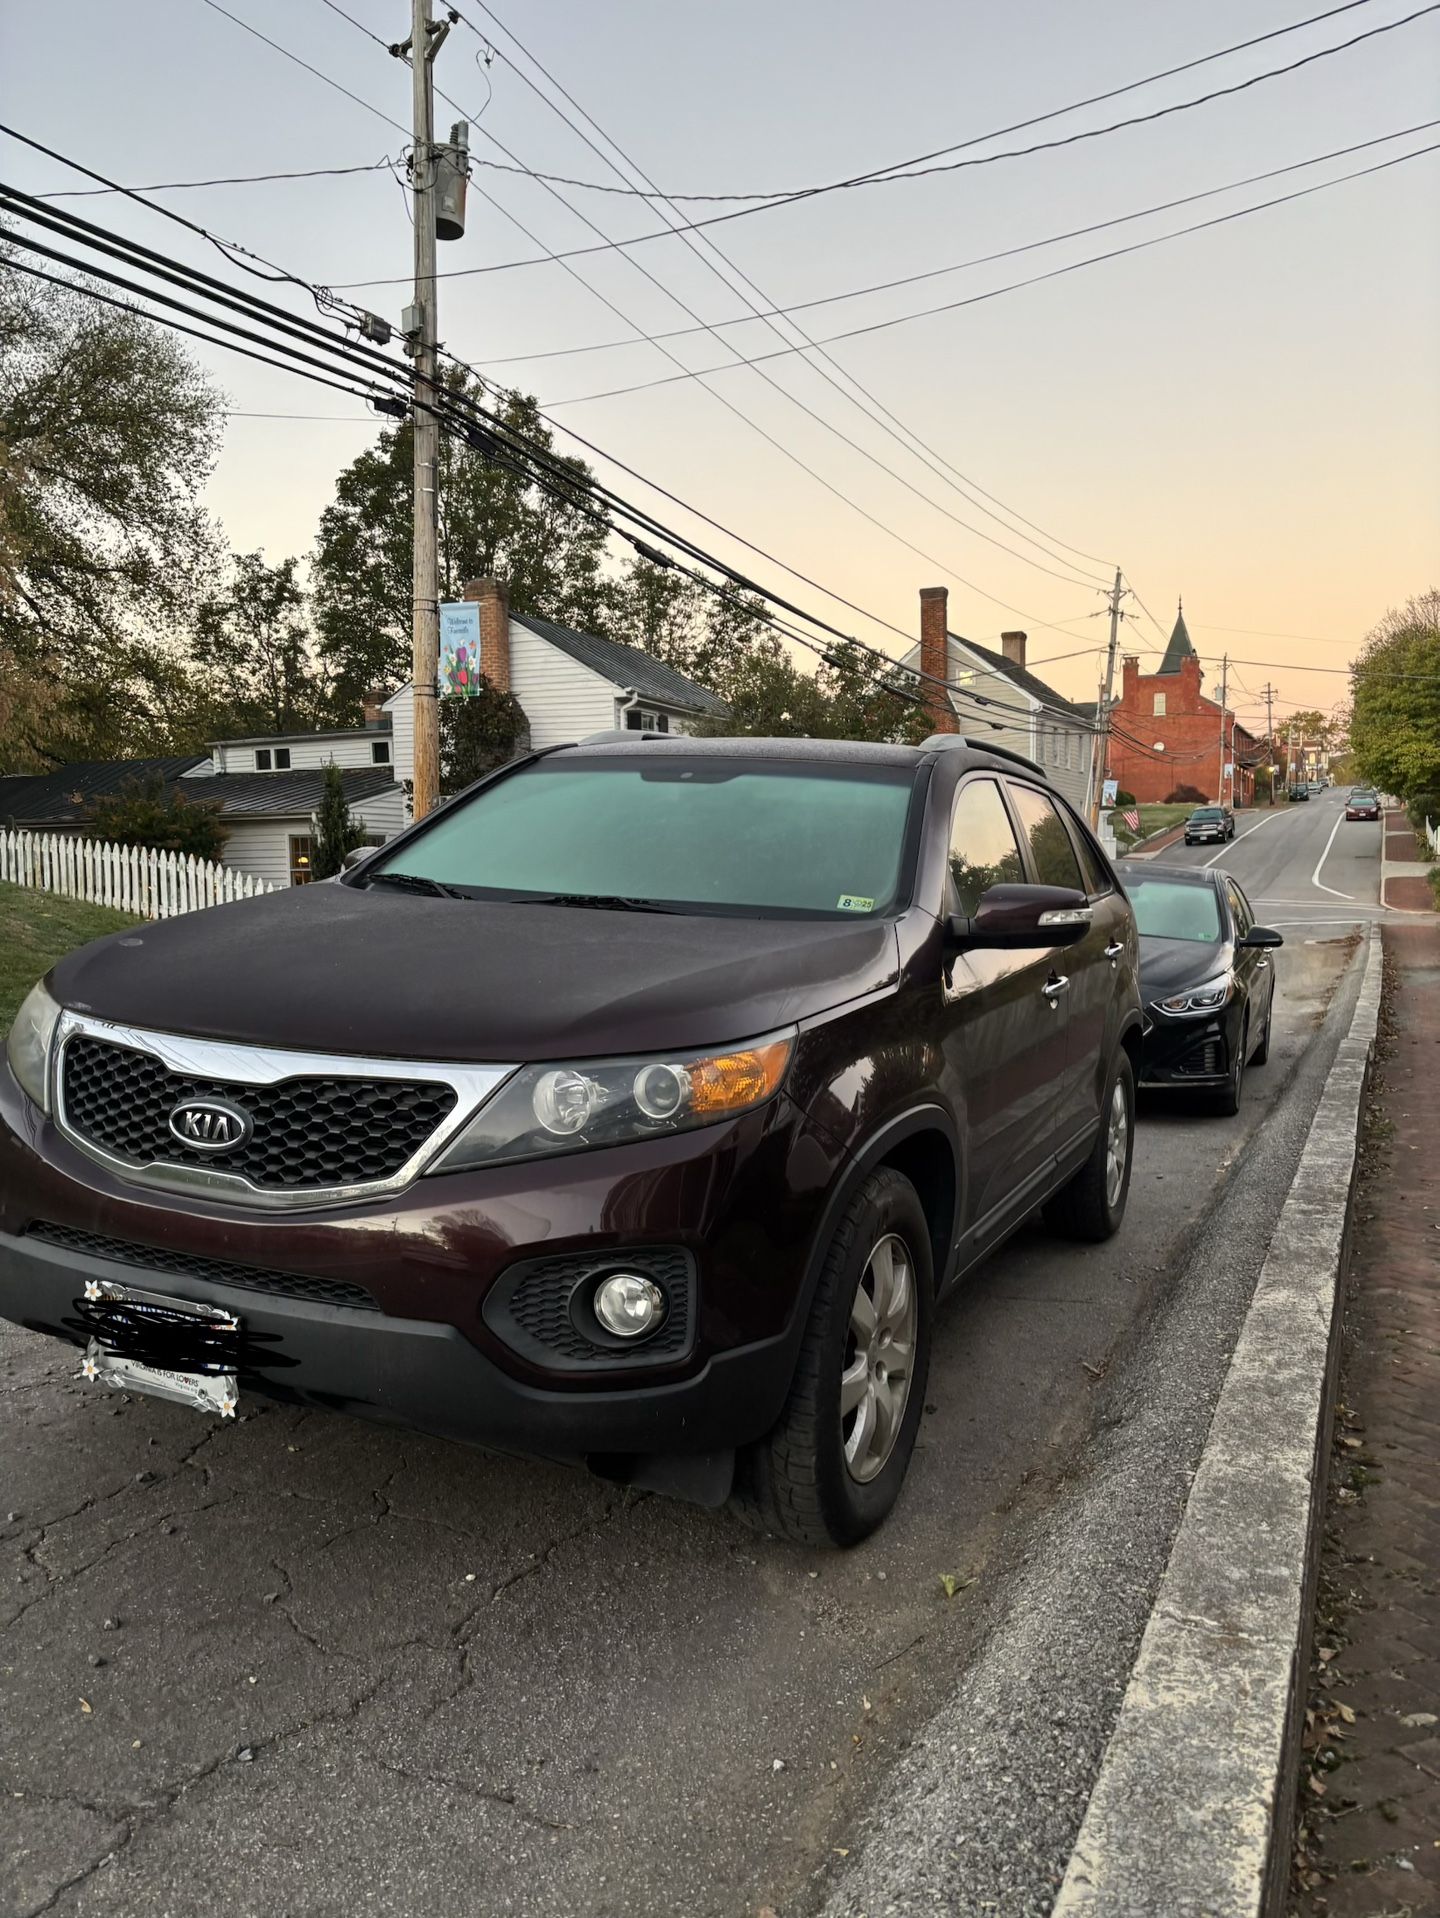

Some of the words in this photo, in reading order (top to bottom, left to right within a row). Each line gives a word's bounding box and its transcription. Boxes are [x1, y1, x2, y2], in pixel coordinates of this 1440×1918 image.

[843, 898, 852, 907] 8
[184, 1111, 229, 1140] KIA
[163, 1370, 175, 1380] FOR
